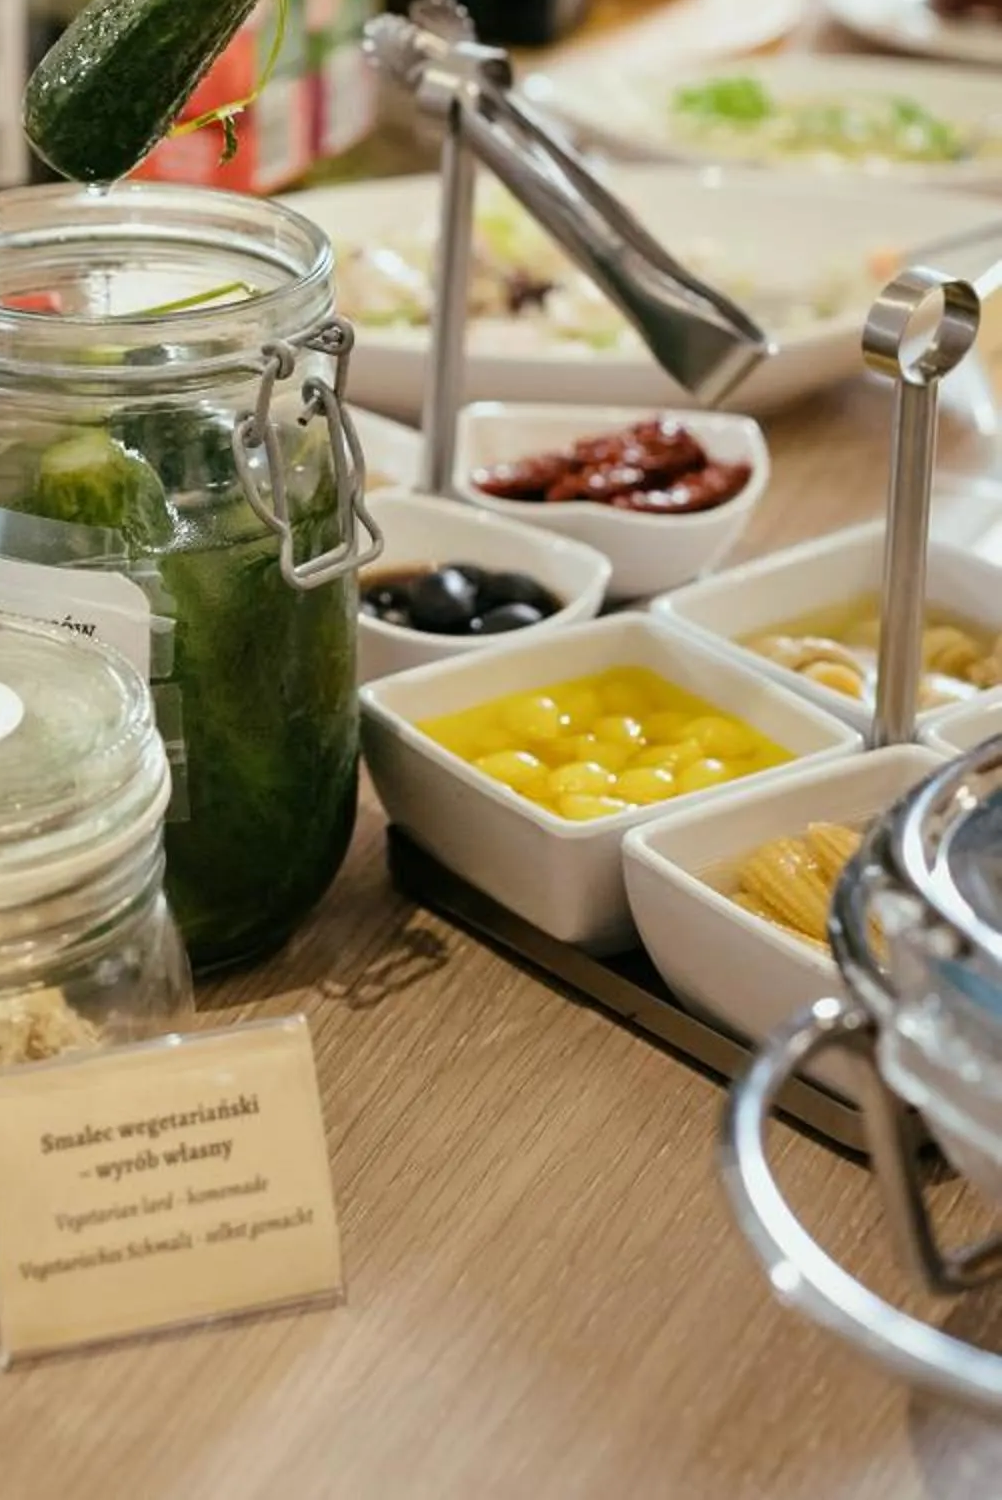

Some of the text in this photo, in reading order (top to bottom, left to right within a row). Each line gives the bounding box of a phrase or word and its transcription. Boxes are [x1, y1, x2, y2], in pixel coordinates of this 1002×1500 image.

[39, 1093, 260, 1155] Smalec wegetariański
[94, 1149, 160, 1182] wyrób
[163, 1138, 234, 1166] własny
